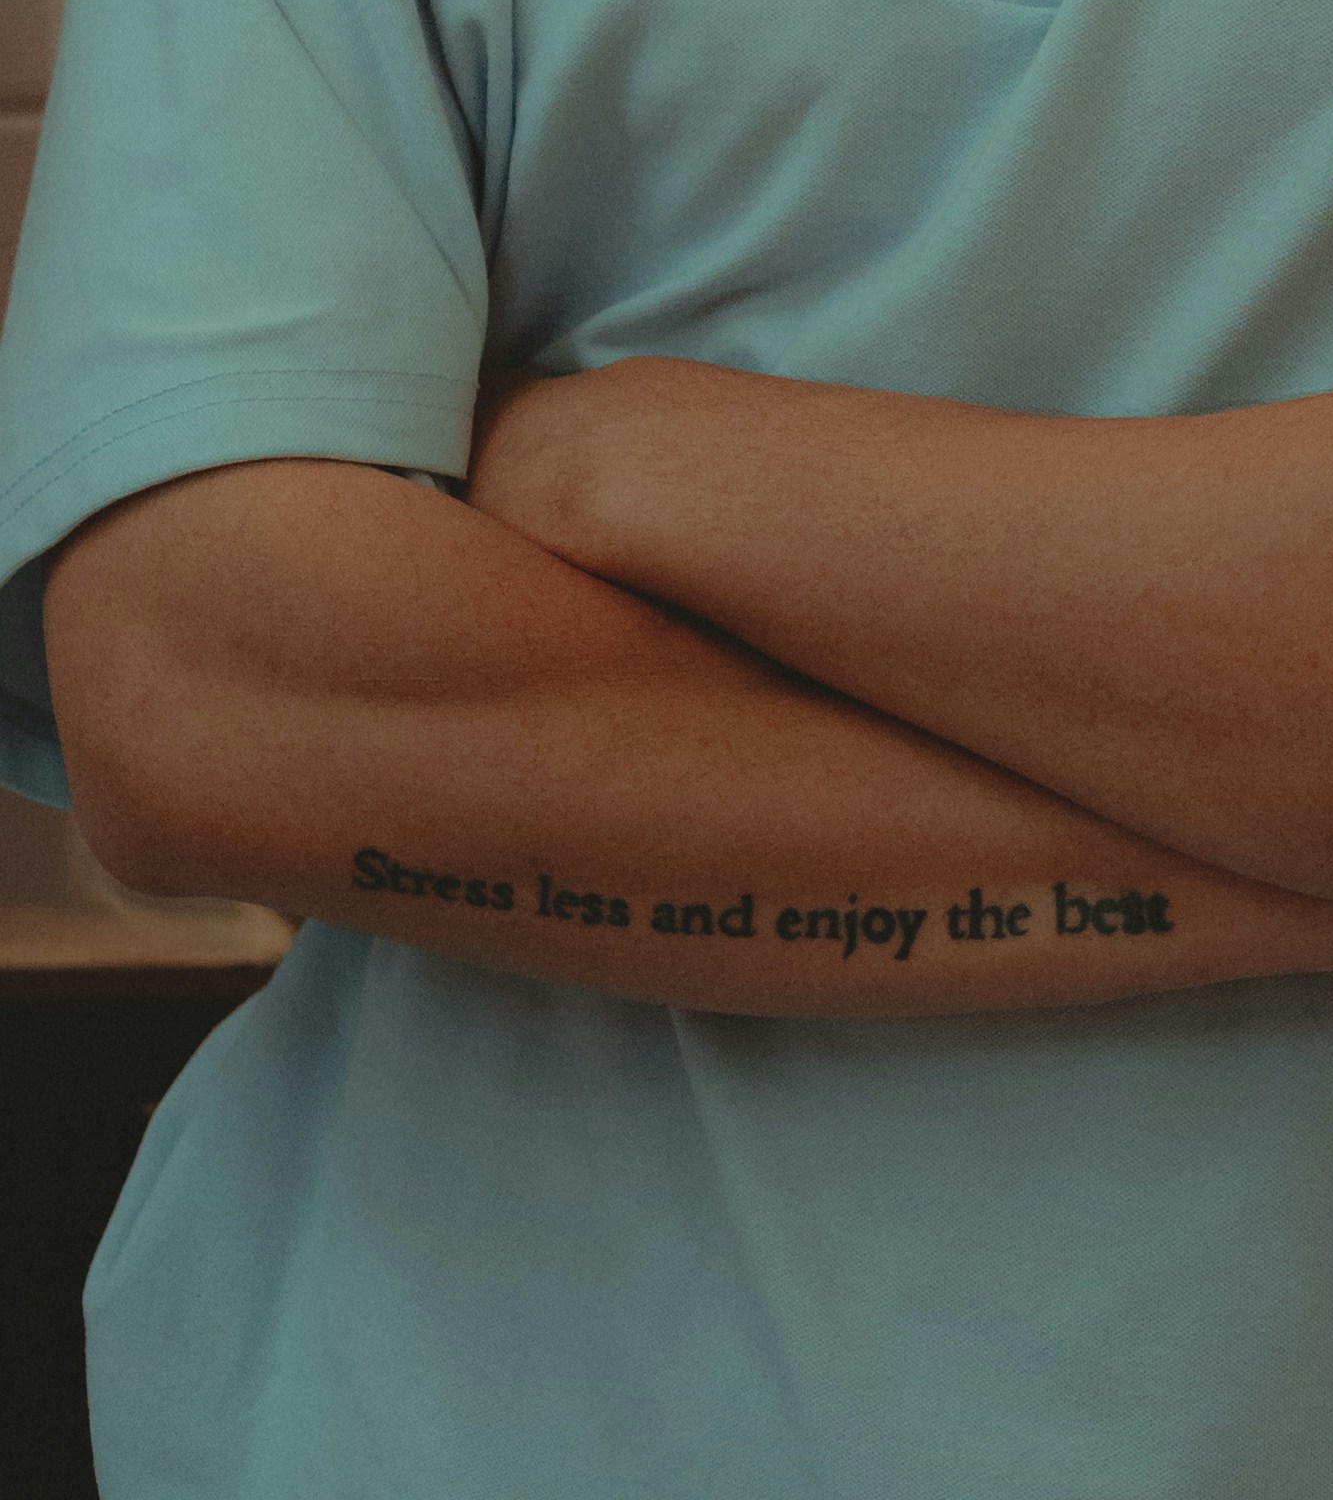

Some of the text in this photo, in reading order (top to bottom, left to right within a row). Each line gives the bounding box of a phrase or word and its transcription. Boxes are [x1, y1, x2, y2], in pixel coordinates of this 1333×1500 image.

[352, 846, 1174, 961] Stress less and enjoy the best
